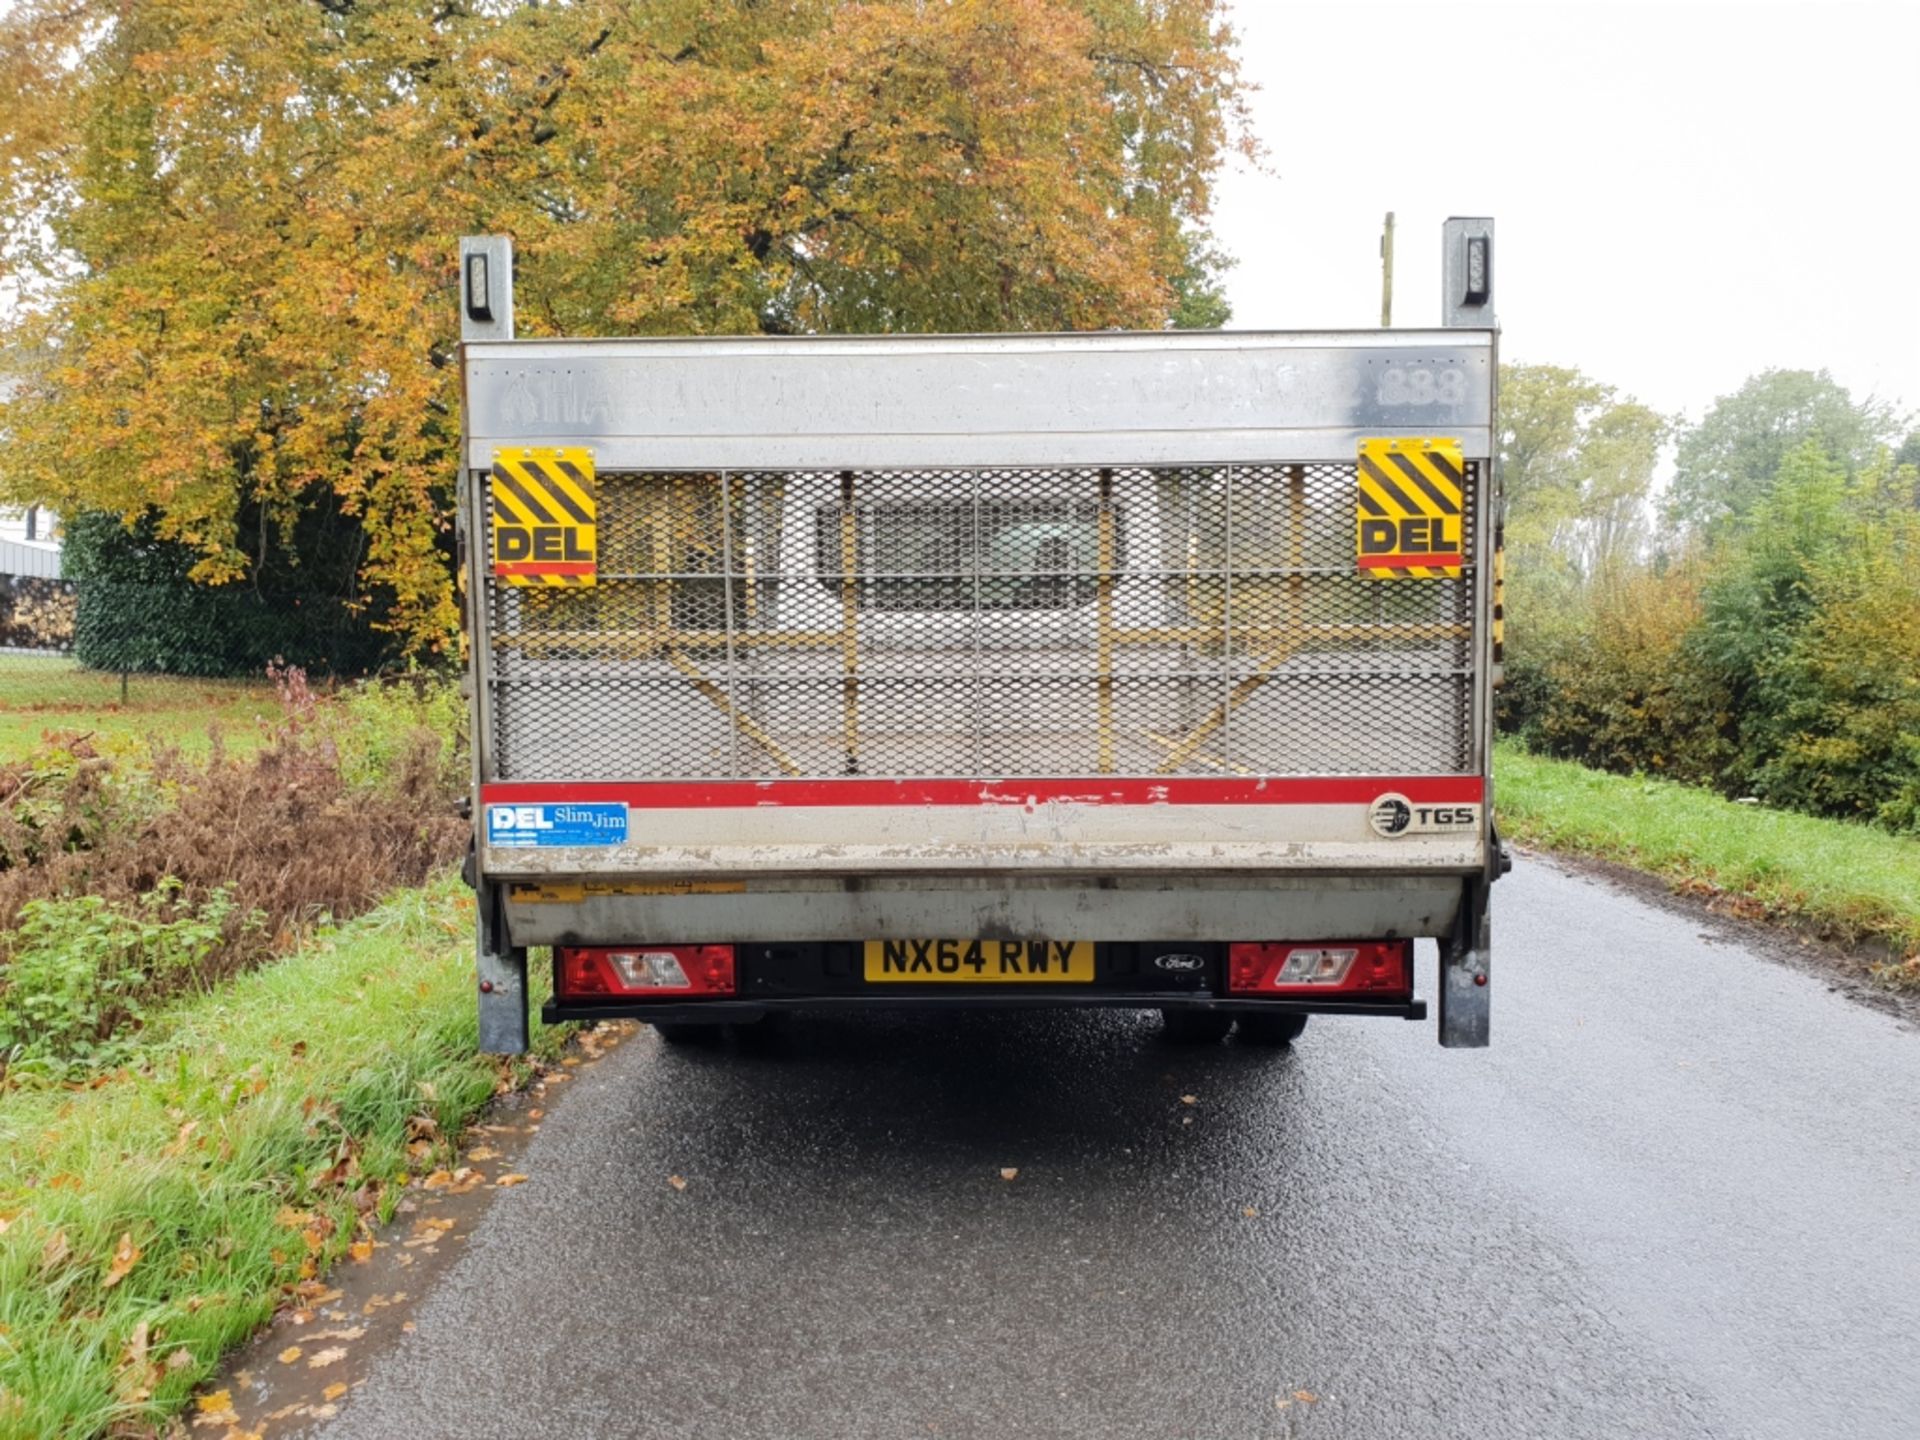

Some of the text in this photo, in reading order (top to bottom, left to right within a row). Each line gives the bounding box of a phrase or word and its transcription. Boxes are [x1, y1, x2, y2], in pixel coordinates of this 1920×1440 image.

[496, 527, 593, 561] DEL
[1361, 518, 1457, 553] DEL
[493, 807, 626, 829] DEL Slim Jim
[1415, 808, 1474, 824] TGS
[882, 940, 1075, 973] NX64 RWY
[1165, 954, 1196, 969] Ford
